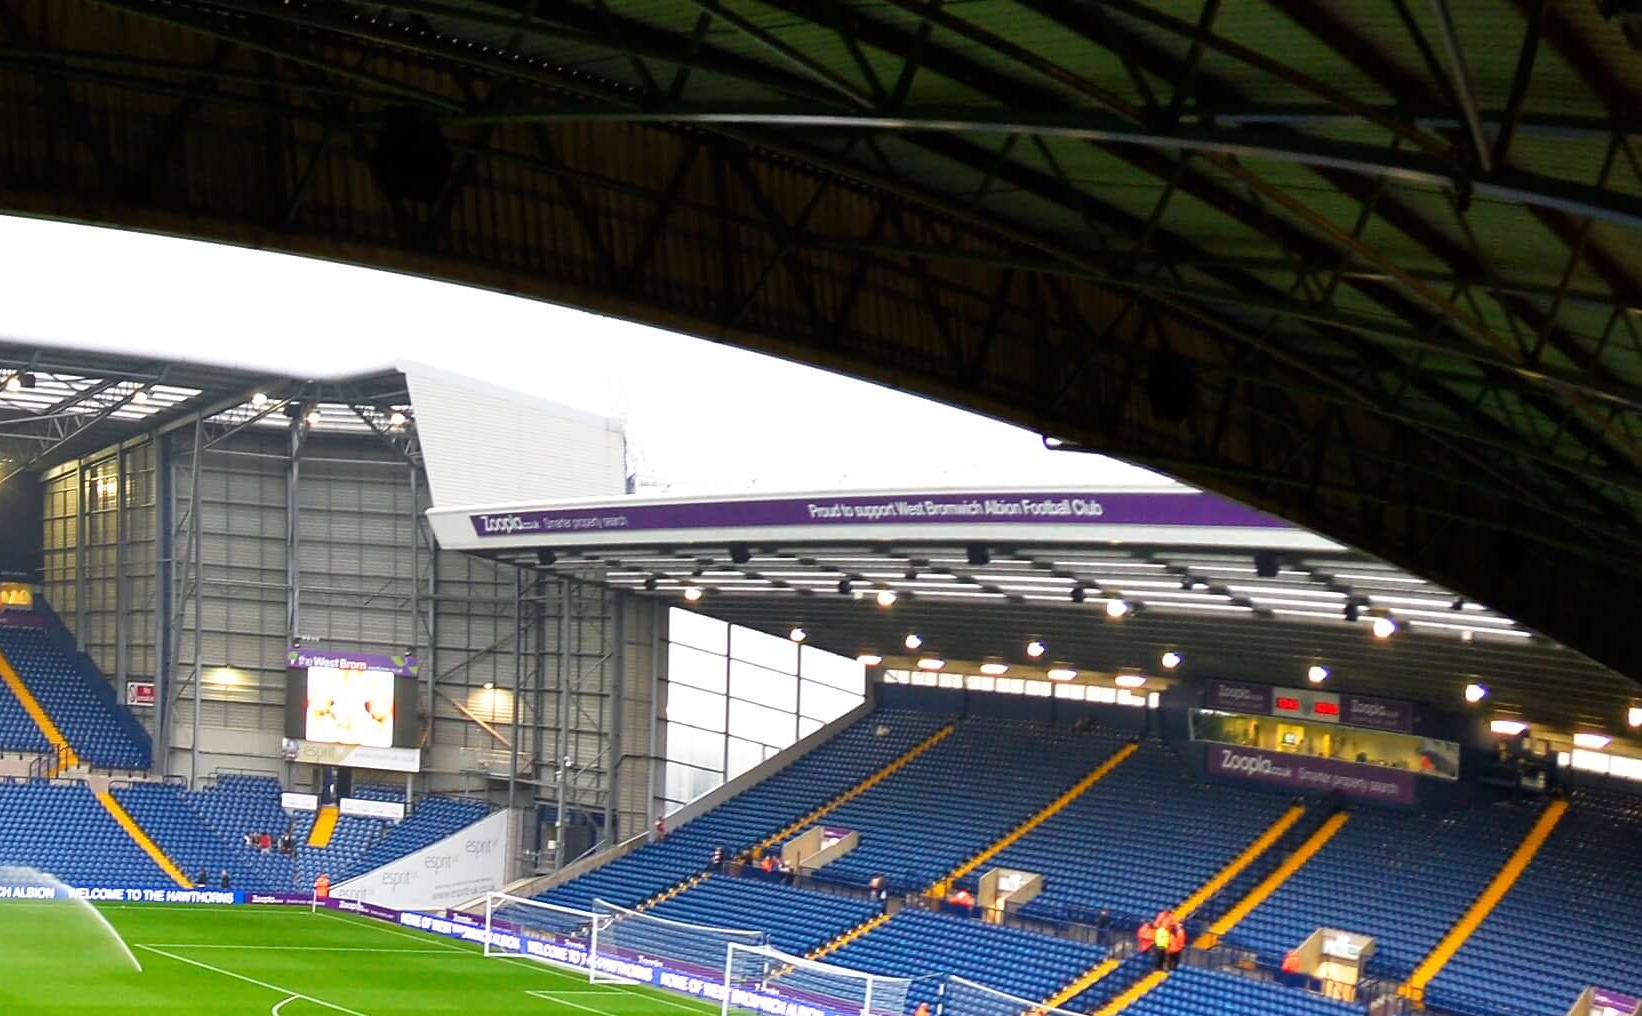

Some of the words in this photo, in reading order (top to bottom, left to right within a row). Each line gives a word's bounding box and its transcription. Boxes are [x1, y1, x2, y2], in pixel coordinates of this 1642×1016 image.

[808, 503, 841, 519] Proud
[841, 504, 853, 517] to
[855, 503, 896, 519] support
[896, 502, 926, 516] West
[927, 501, 983, 516] Bromwich
[985, 500, 1022, 515] Albion
[1023, 500, 1070, 515] Football
[1072, 500, 1103, 515] Club
[314, 657, 339, 668] West
[339, 659, 367, 670] Brom
[13, 886, 56, 900] ALBION
[68, 887, 121, 901] WELCOME
[123, 888, 140, 901] TO
[142, 889, 165, 902] THE
[166, 889, 234, 904] HAWTHORNS
[400, 912, 421, 927] HOME
[432, 919, 453, 934] WEST
[527, 940, 567, 961] WELCOME
[661, 972, 689, 991] HOME
[689, 979, 704, 995] OF
